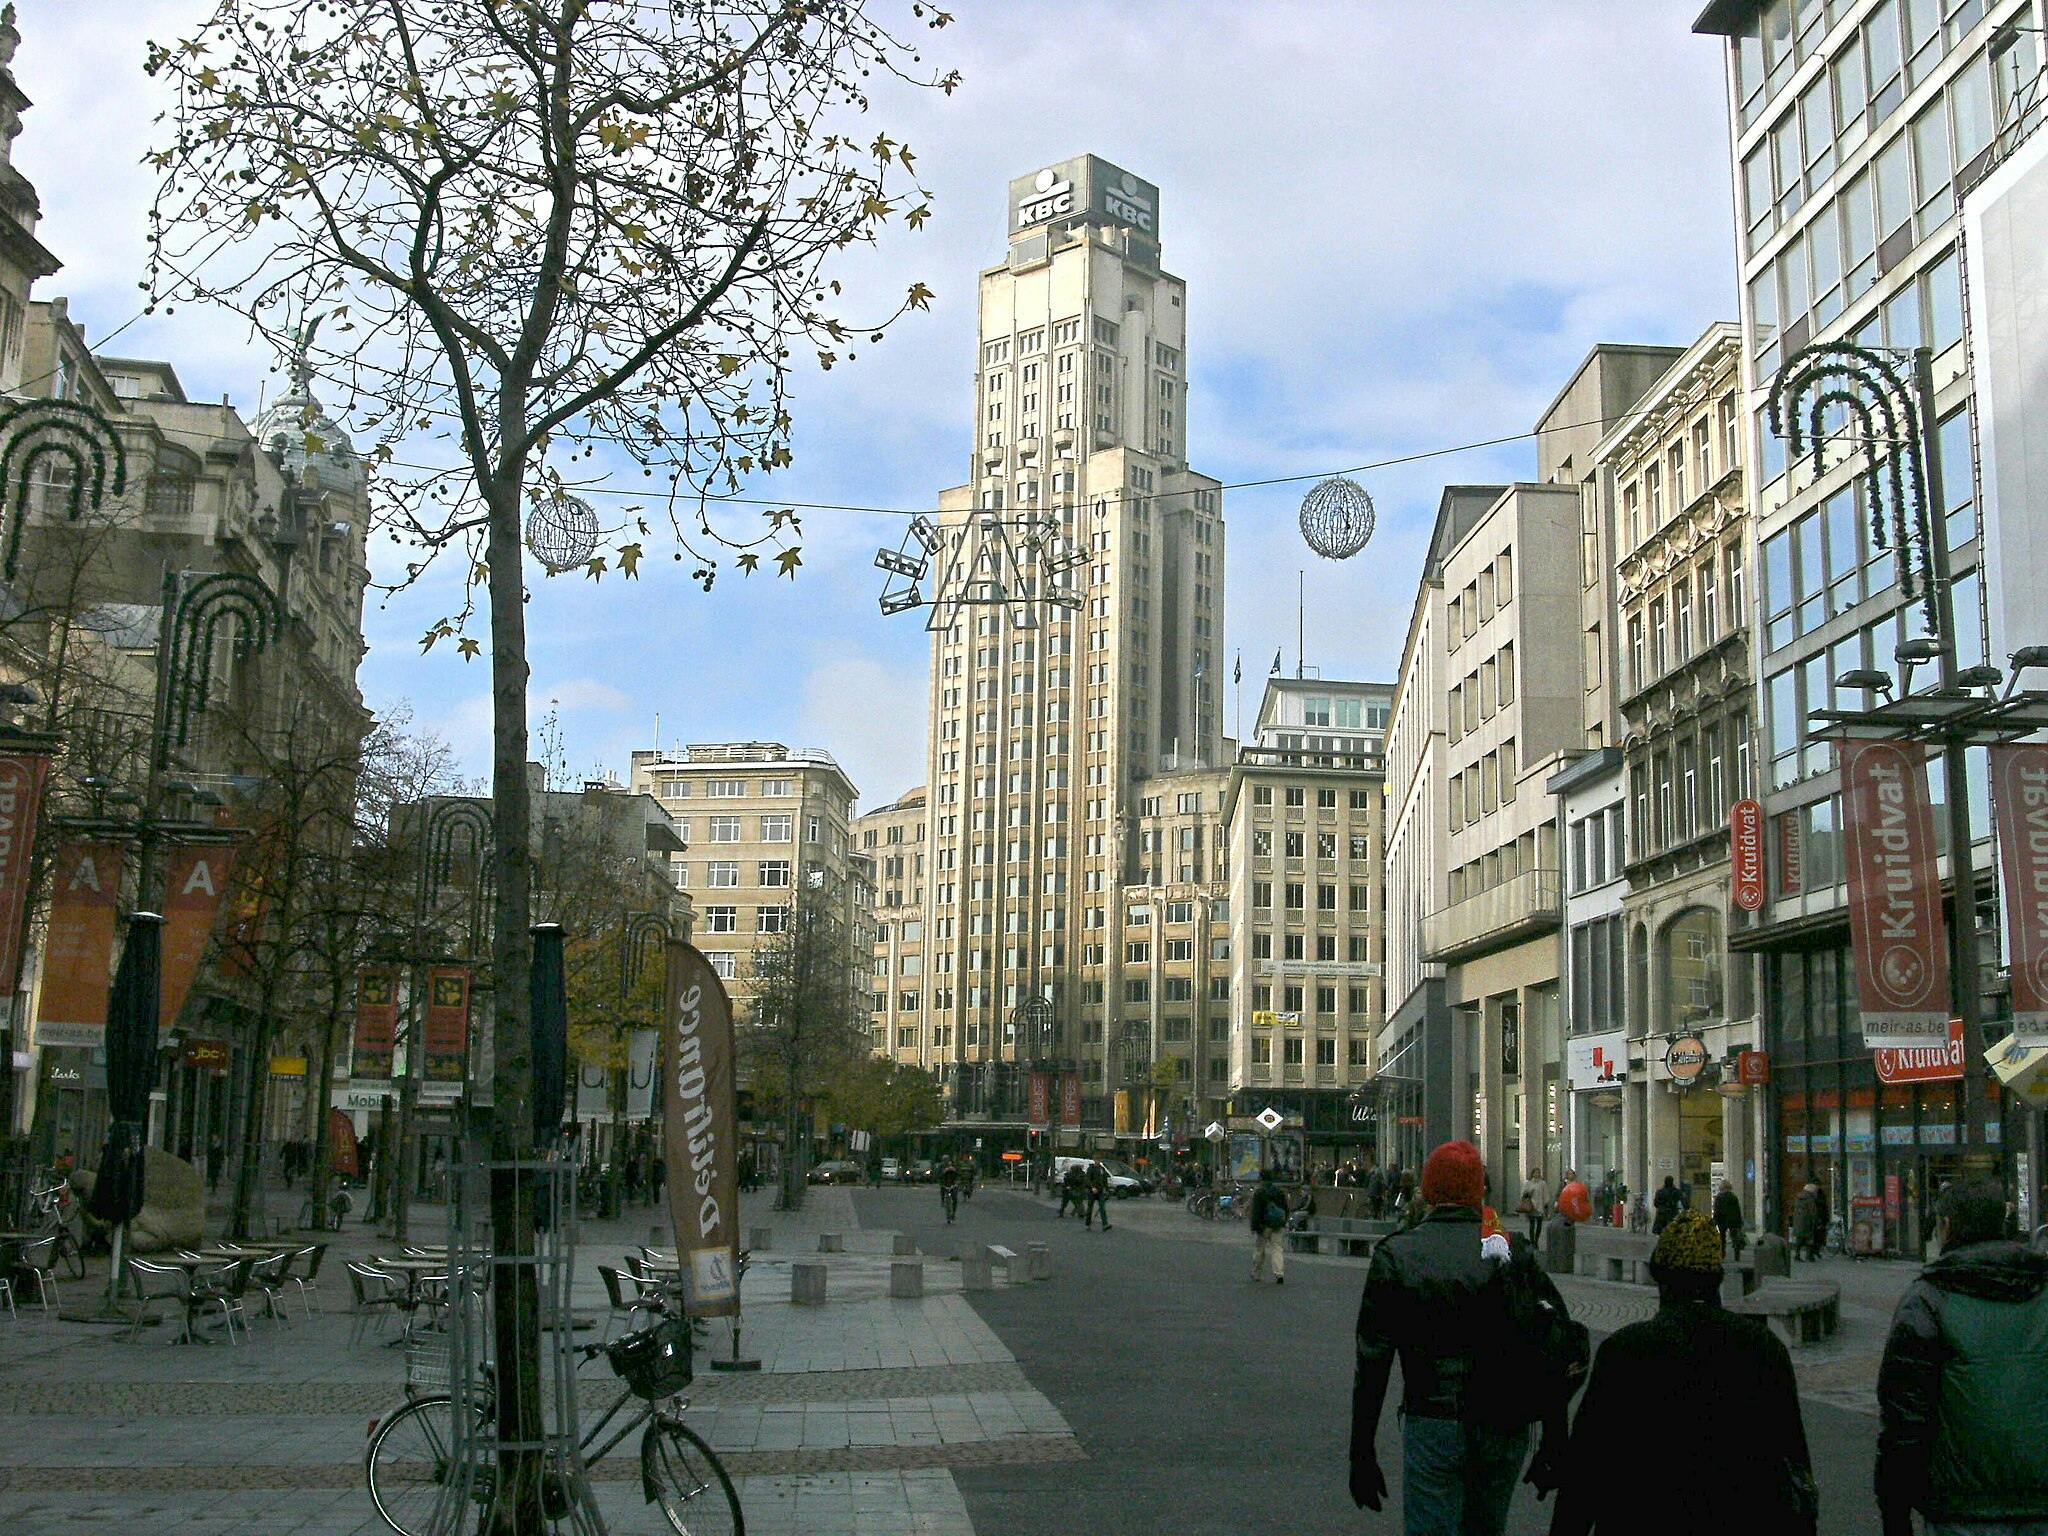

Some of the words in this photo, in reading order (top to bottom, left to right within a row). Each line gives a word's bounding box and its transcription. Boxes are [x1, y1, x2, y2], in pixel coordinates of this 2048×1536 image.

[1017, 193, 1070, 227] KBC
[1105, 195, 1152, 231] KBC
[1740, 807, 1757, 883] Kruidvat
[1869, 763, 1917, 939] Kruidvat
[182, 860, 215, 896] A
[1865, 1019, 1945, 1034] meir-as.be
